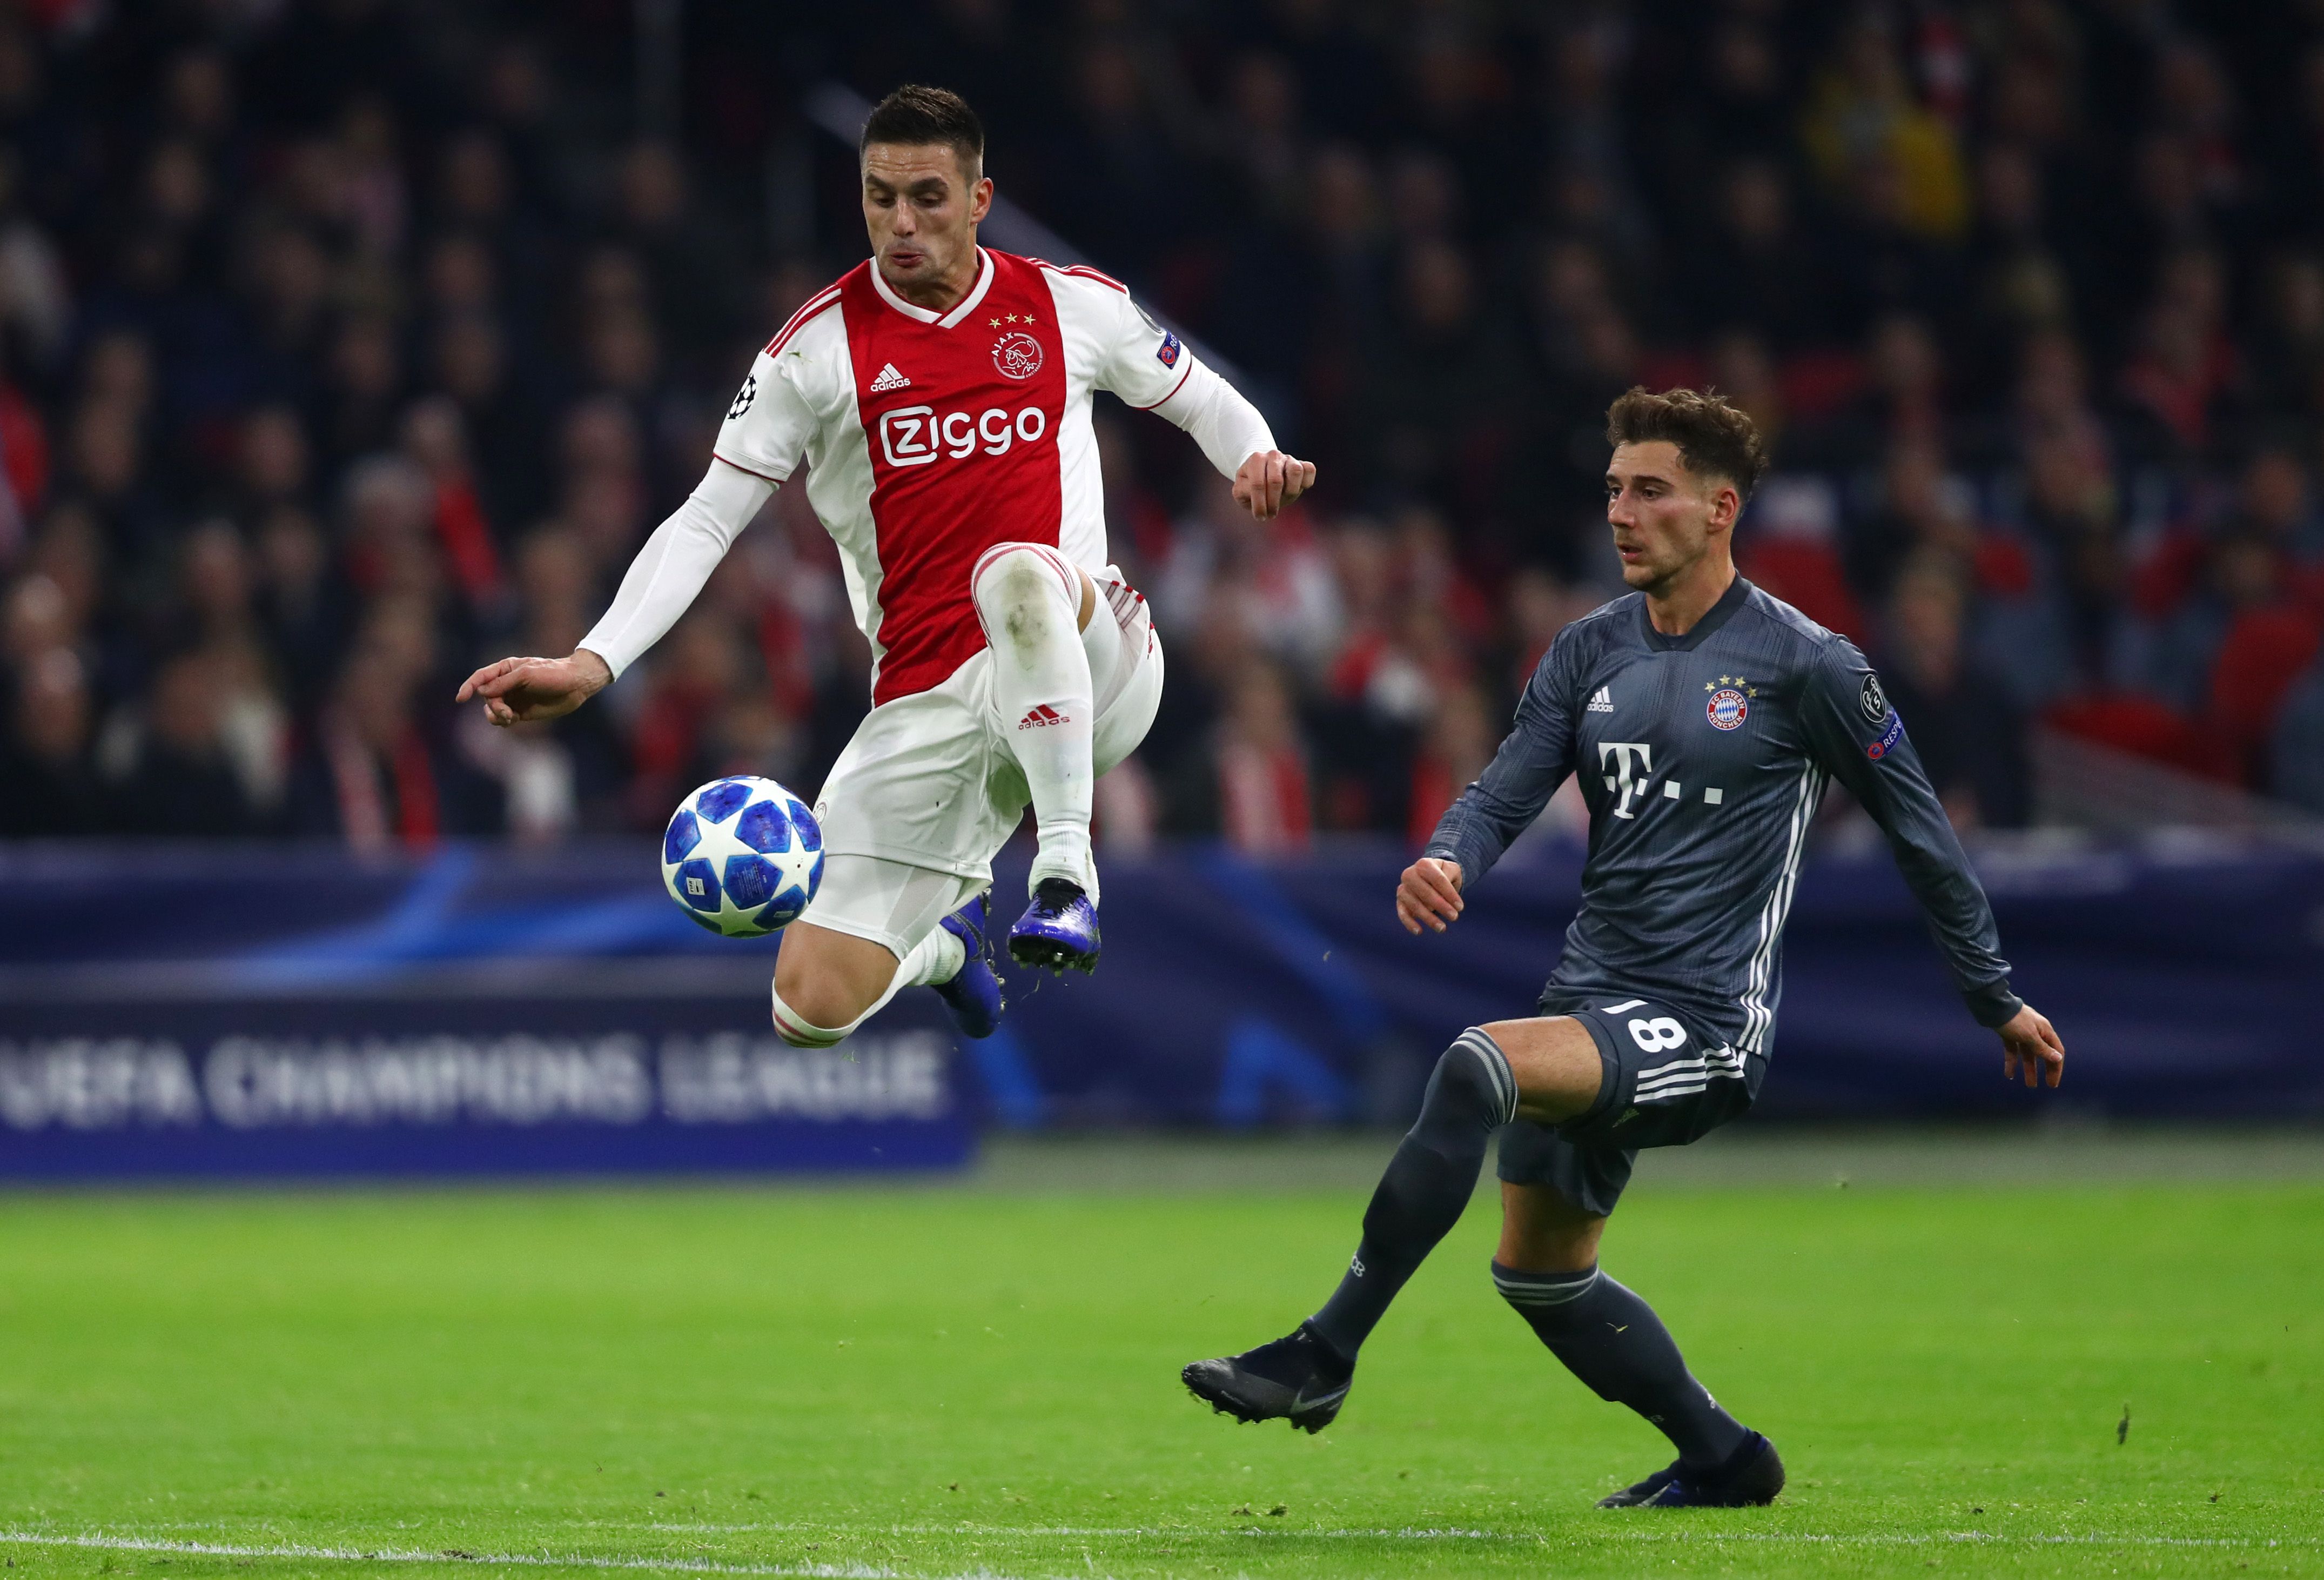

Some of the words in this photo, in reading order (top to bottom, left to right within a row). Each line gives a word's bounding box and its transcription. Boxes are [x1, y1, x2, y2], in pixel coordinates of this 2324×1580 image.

[991, 332, 1014, 357] AJAX
[1025, 359, 1043, 378] AMSTERDAM
[870, 378, 911, 392] adidas
[1587, 702, 1614, 712] adidas
[1710, 695, 1720, 706] FC
[1720, 692, 1745, 709] BAYERN
[1018, 717, 1070, 730] adidas
[1601, 1000, 1687, 1053] 18
[203, 1031, 649, 1128] CHAMPIONS
[660, 1029, 951, 1124] LEAGUE
